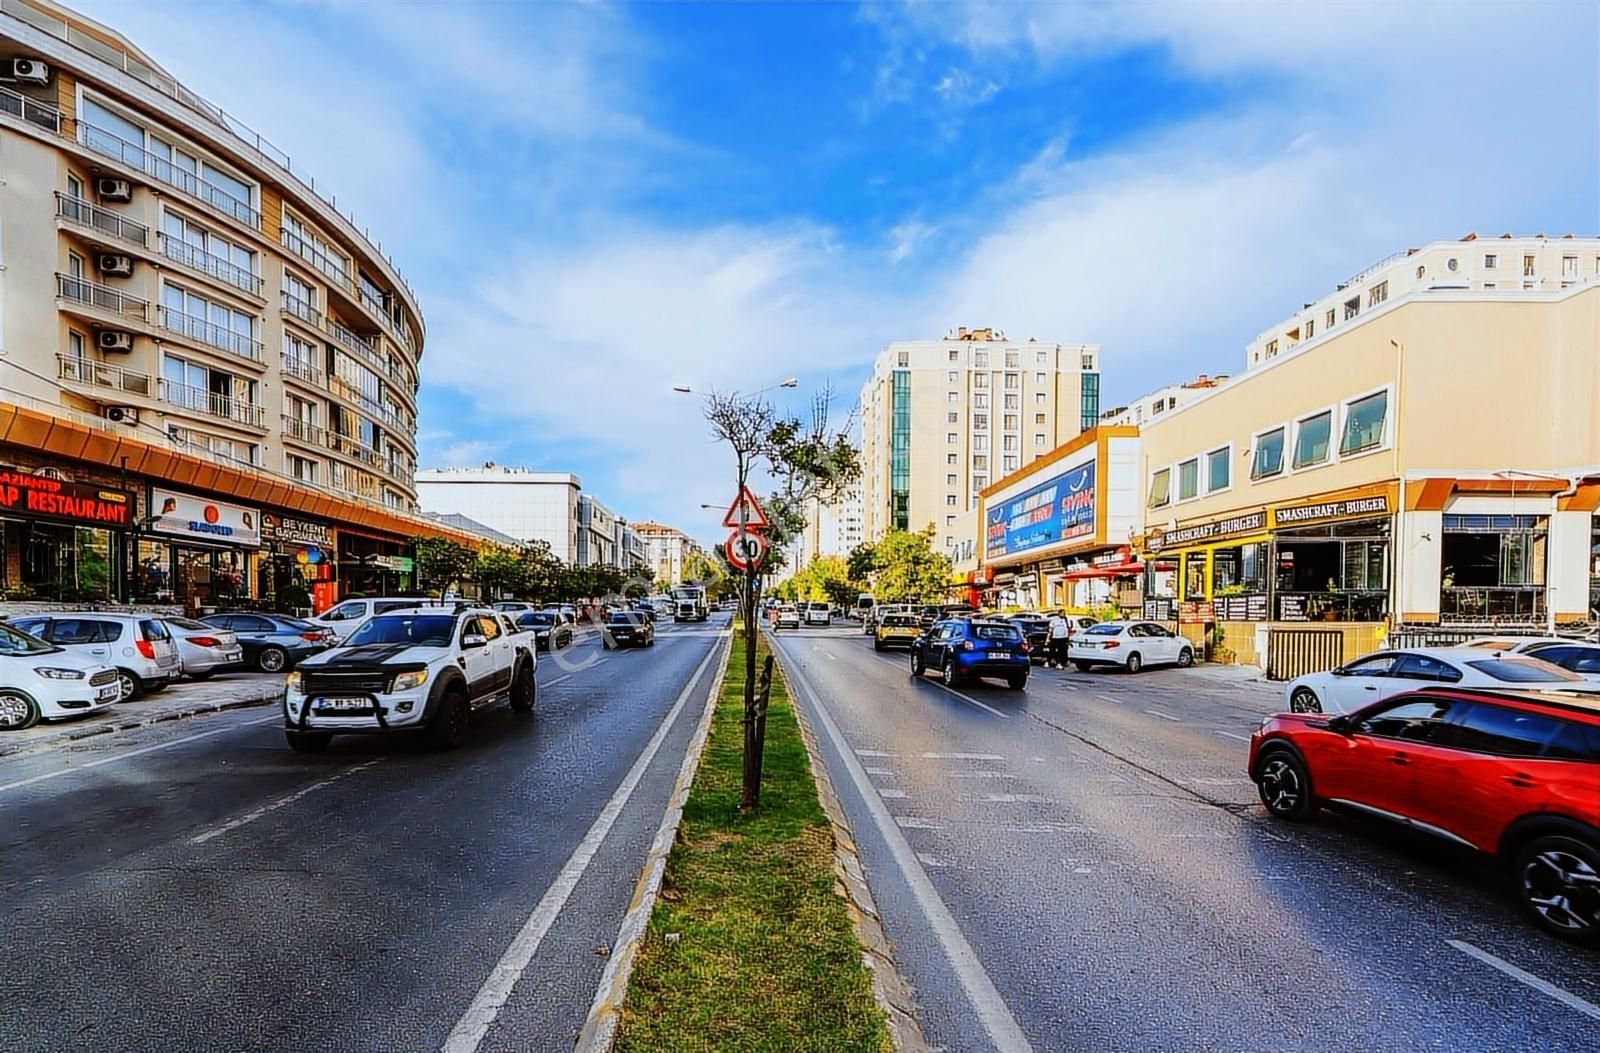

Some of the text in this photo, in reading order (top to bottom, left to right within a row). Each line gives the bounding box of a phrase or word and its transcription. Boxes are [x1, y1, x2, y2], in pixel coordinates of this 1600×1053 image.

[28, 490, 126, 523] RESTAURANT
[1276, 498, 1386, 522] SMASHCRAFT BURGER
[1166, 524, 1215, 545] SMASHCRAFT
[1220, 514, 1261, 534] BURGER
[735, 539, 758, 558] 30
